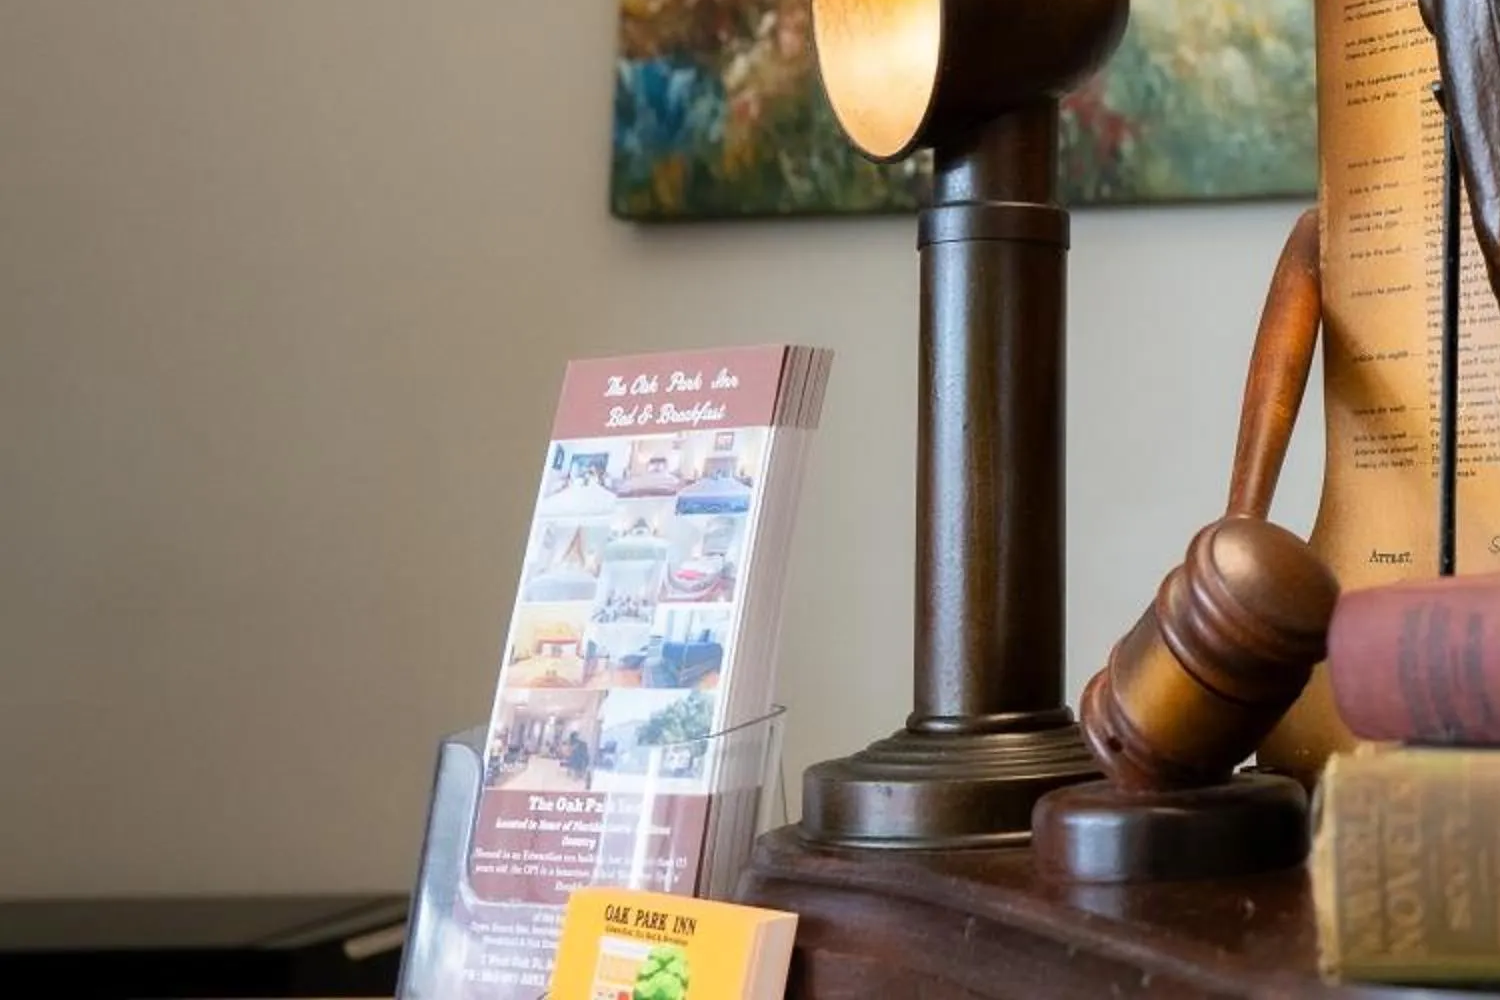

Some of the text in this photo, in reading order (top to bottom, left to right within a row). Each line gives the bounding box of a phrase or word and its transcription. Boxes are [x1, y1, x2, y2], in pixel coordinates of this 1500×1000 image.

[528, 795, 553, 811] The
[604, 903, 631, 926] OAK
[632, 909, 669, 932] PARK
[671, 915, 698, 937] INN
